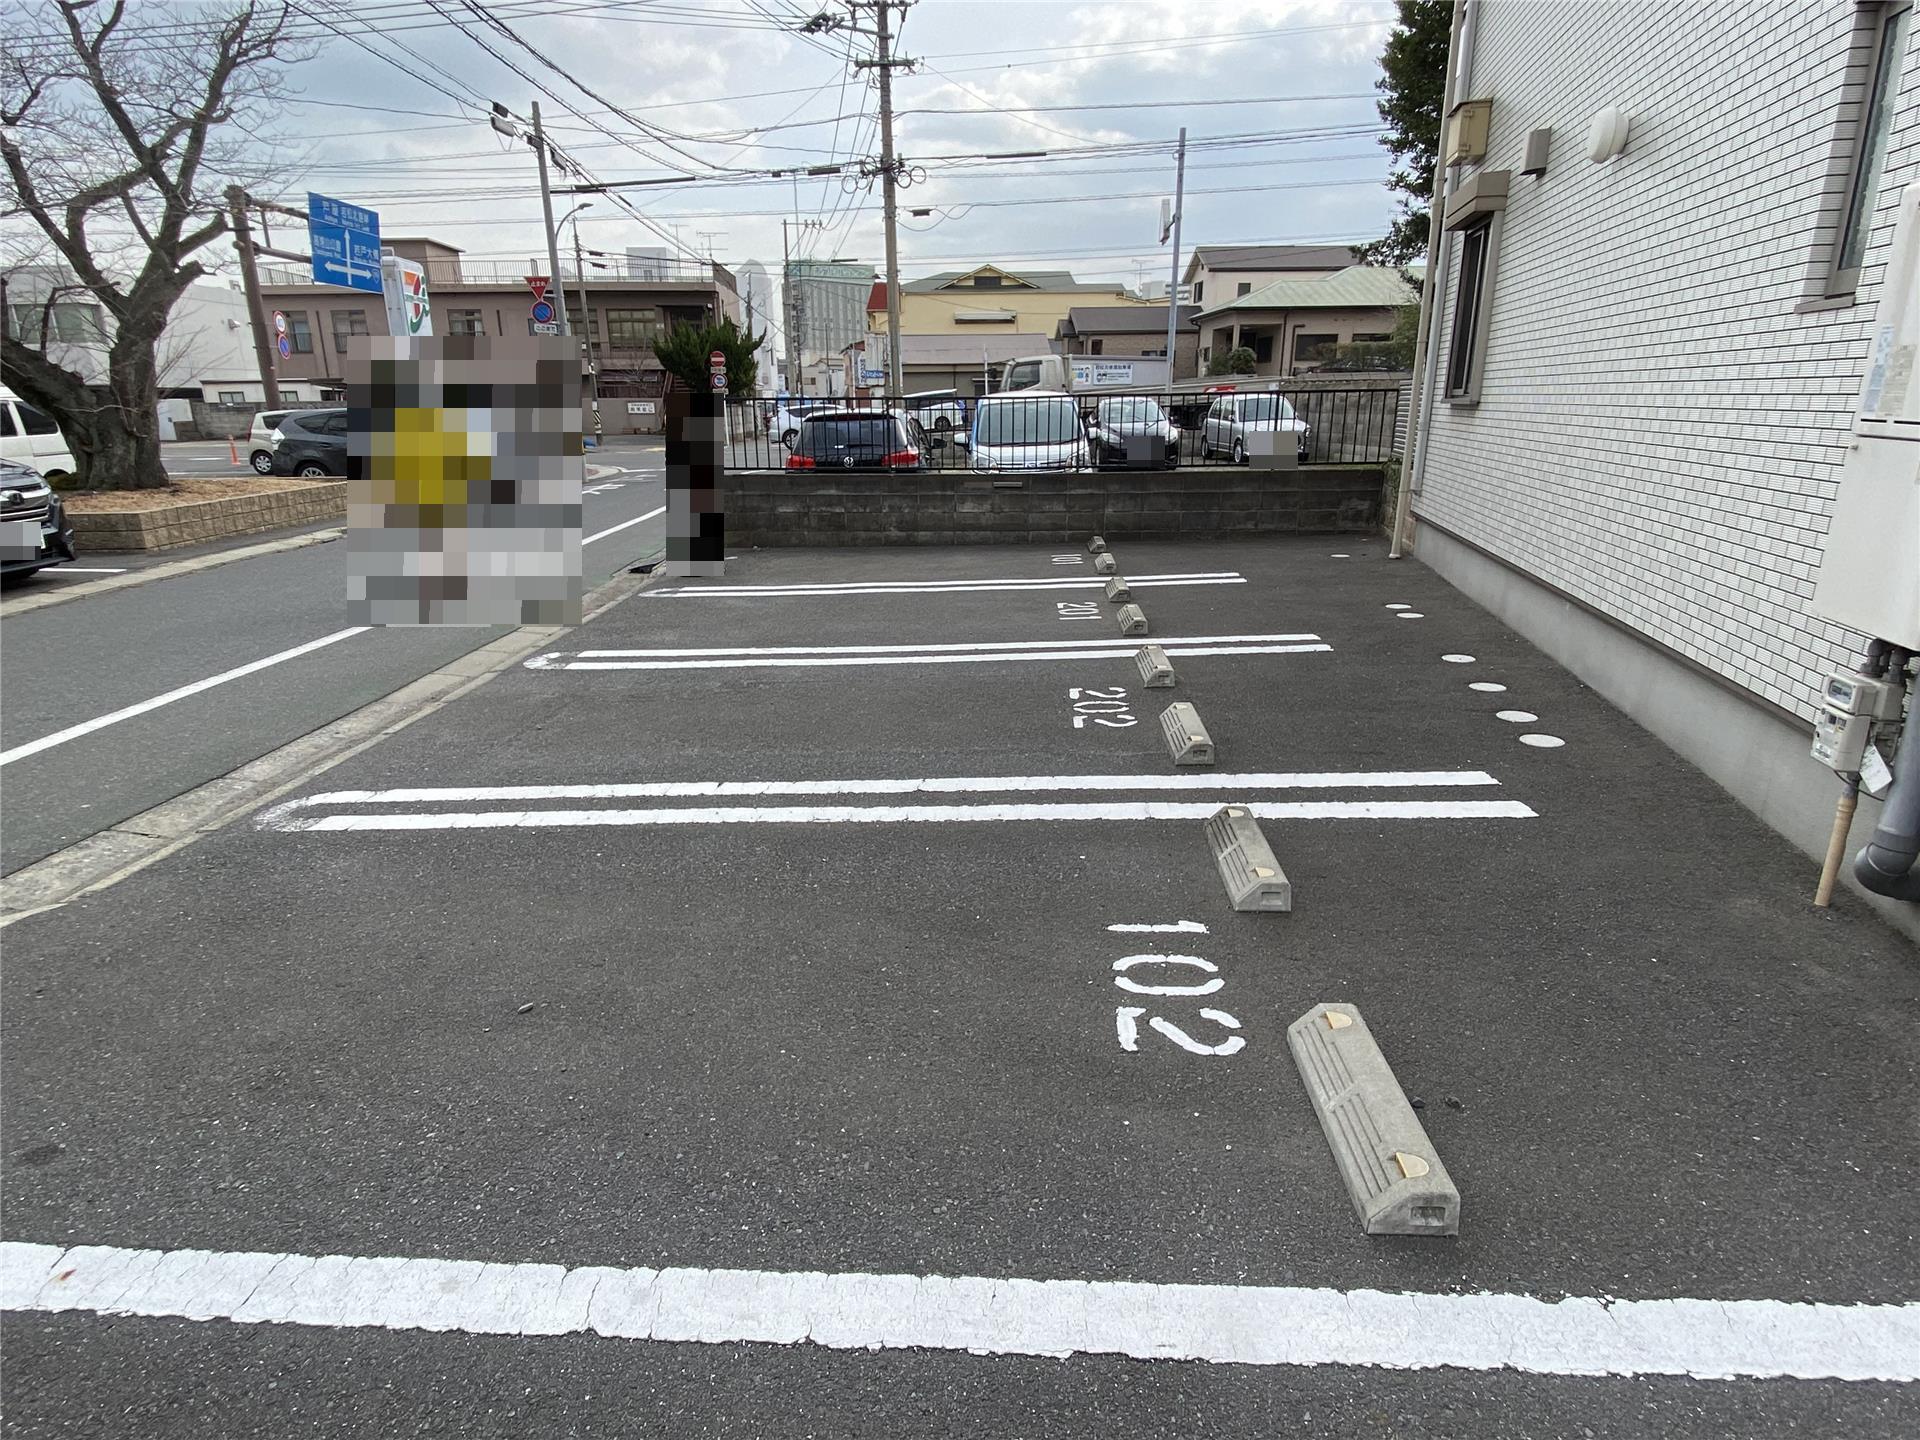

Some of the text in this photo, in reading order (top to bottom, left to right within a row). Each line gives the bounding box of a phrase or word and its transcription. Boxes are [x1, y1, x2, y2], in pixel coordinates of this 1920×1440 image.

[1051, 554, 1084, 565] 101
[1056, 602, 1102, 620] 201
[1069, 686, 1138, 729] 202
[1106, 920, 1247, 1056] 102
